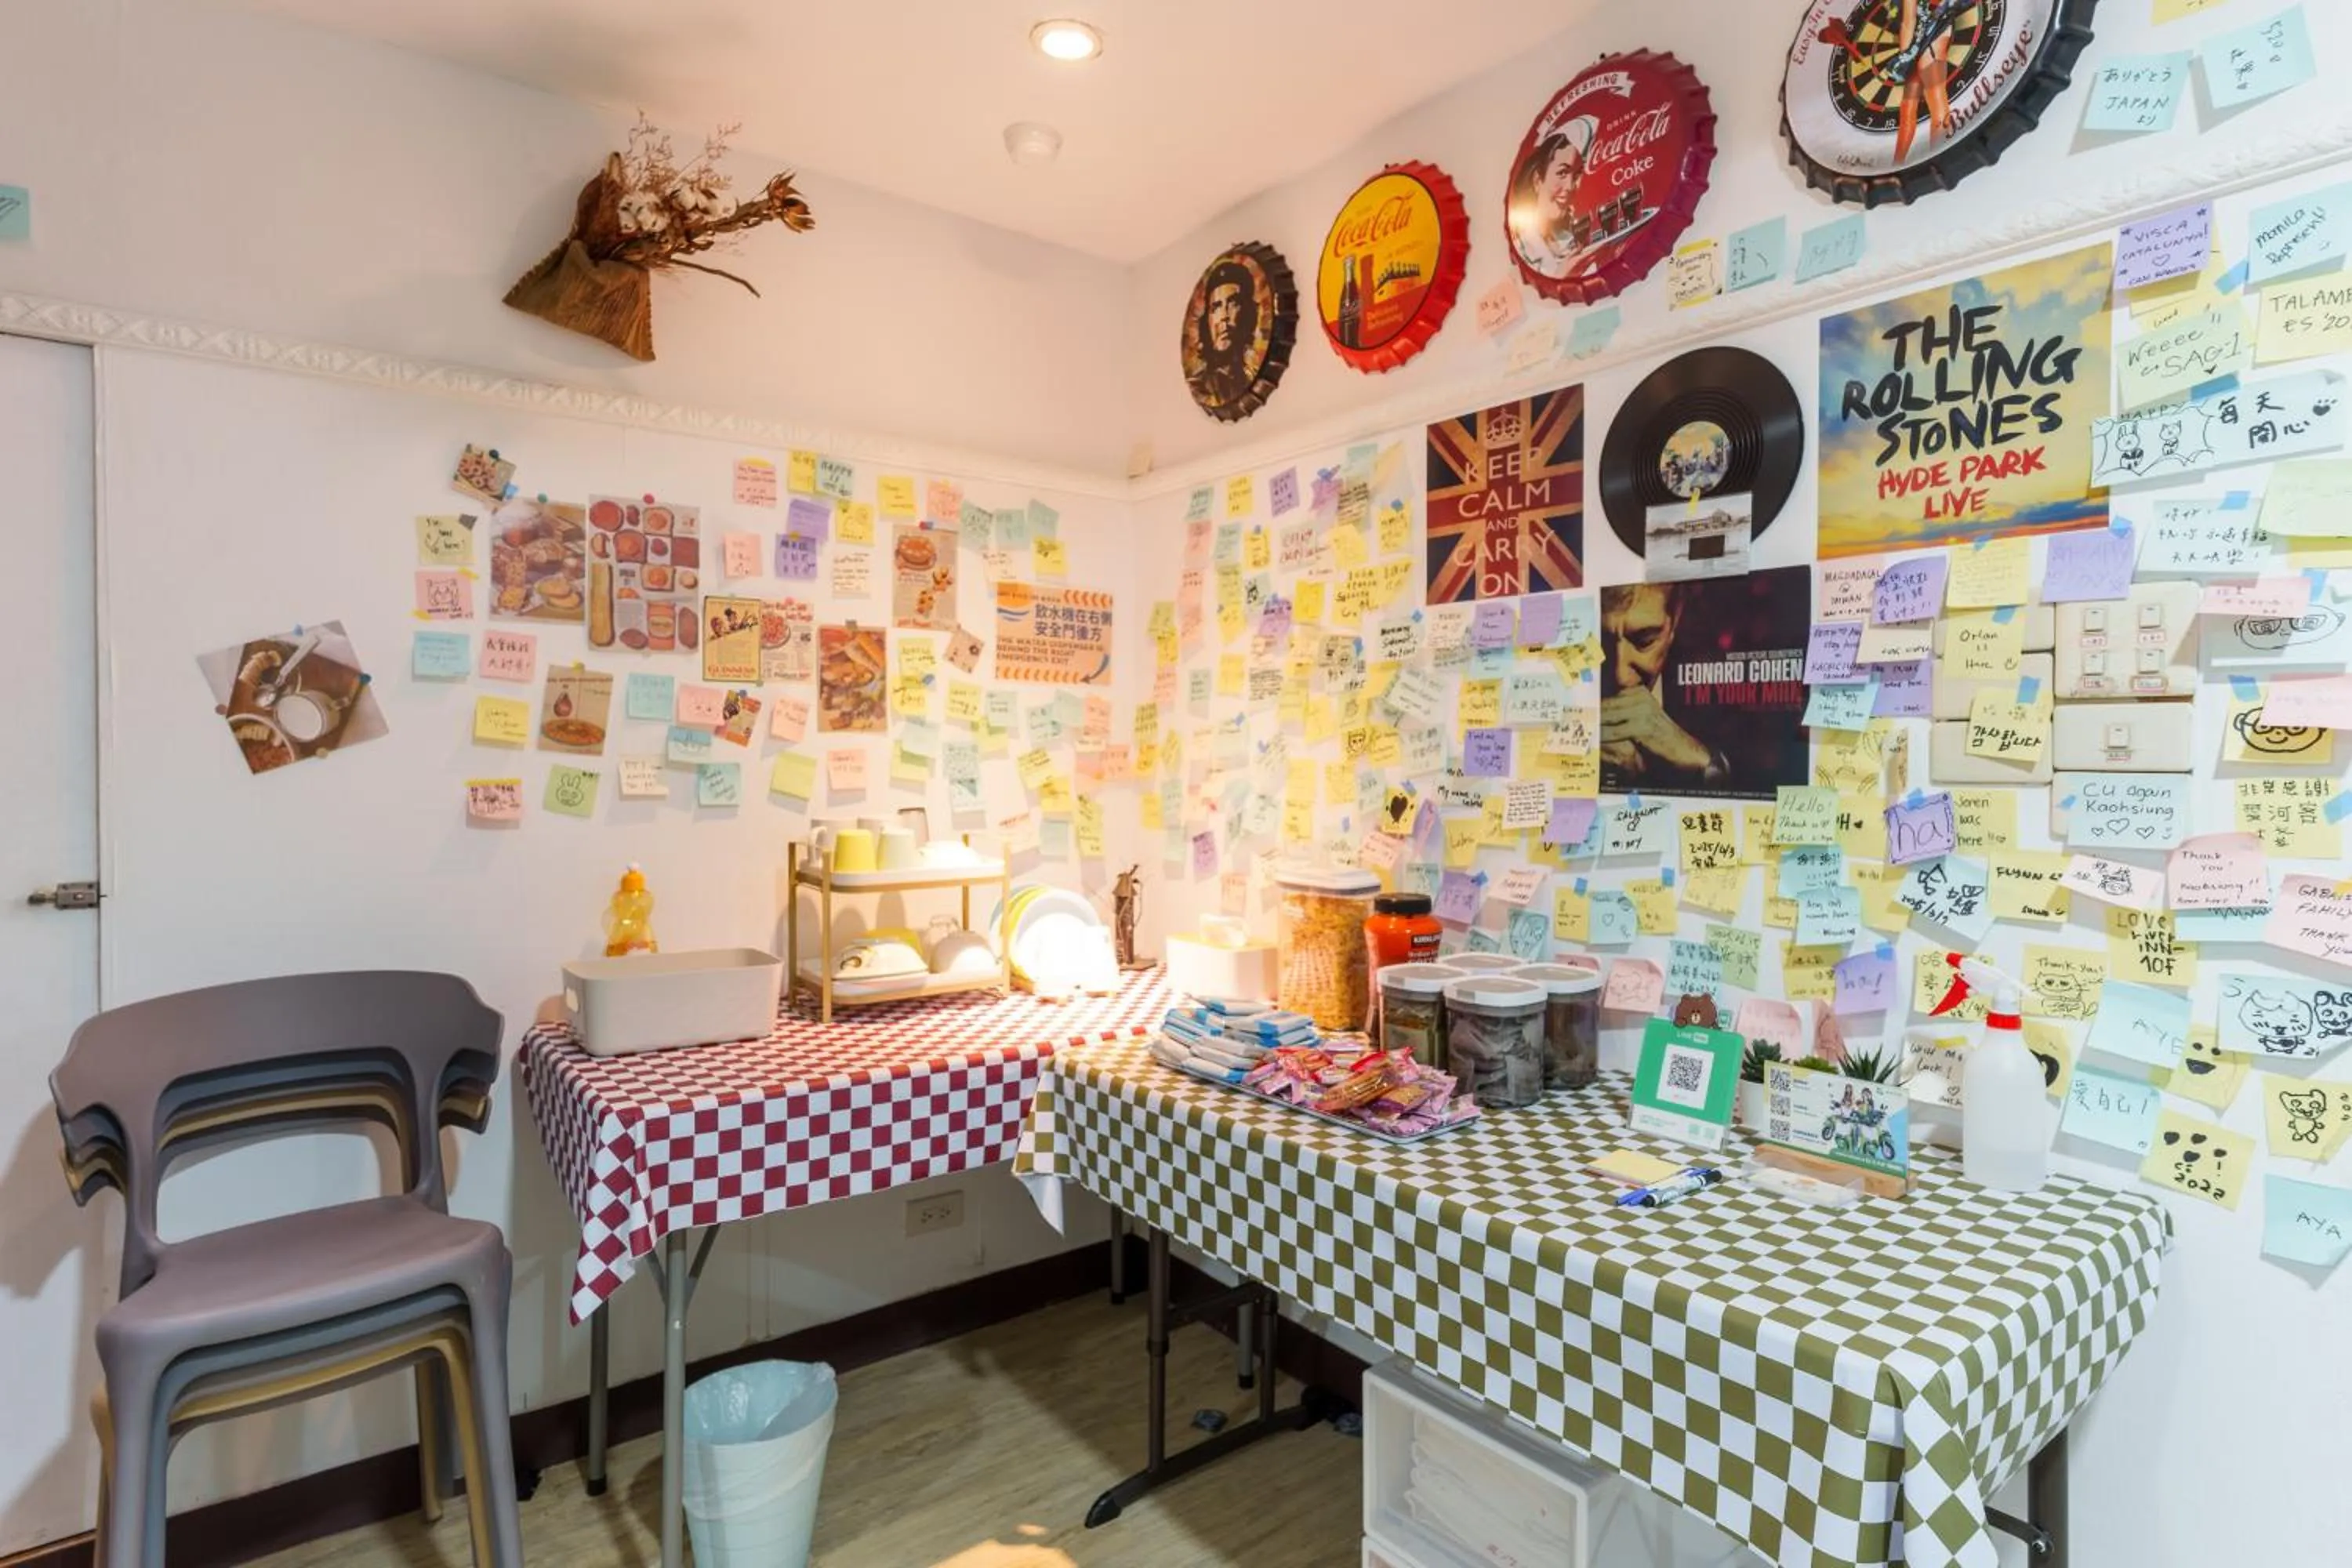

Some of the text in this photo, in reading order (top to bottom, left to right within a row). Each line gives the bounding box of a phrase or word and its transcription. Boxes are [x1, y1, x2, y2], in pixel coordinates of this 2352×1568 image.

[2104, 96, 2169, 111] JAPAN
[1611, 156, 1654, 186] Coke
[1882, 303, 2003, 372] THE
[1841, 335, 2082, 422] ROLLING
[1875, 392, 2063, 467] STONES
[1464, 447, 1542, 485] KEEP
[1959, 445, 2047, 484] PARK
[1458, 478, 1550, 518] CALM
[1923, 487, 1990, 520] LIVE
[1486, 517, 1519, 532] AND
[1480, 572, 1526, 597] ON
[1678, 659, 1803, 686] LEONARD COHEN
[1972, 725, 2042, 752] 감사합니다
